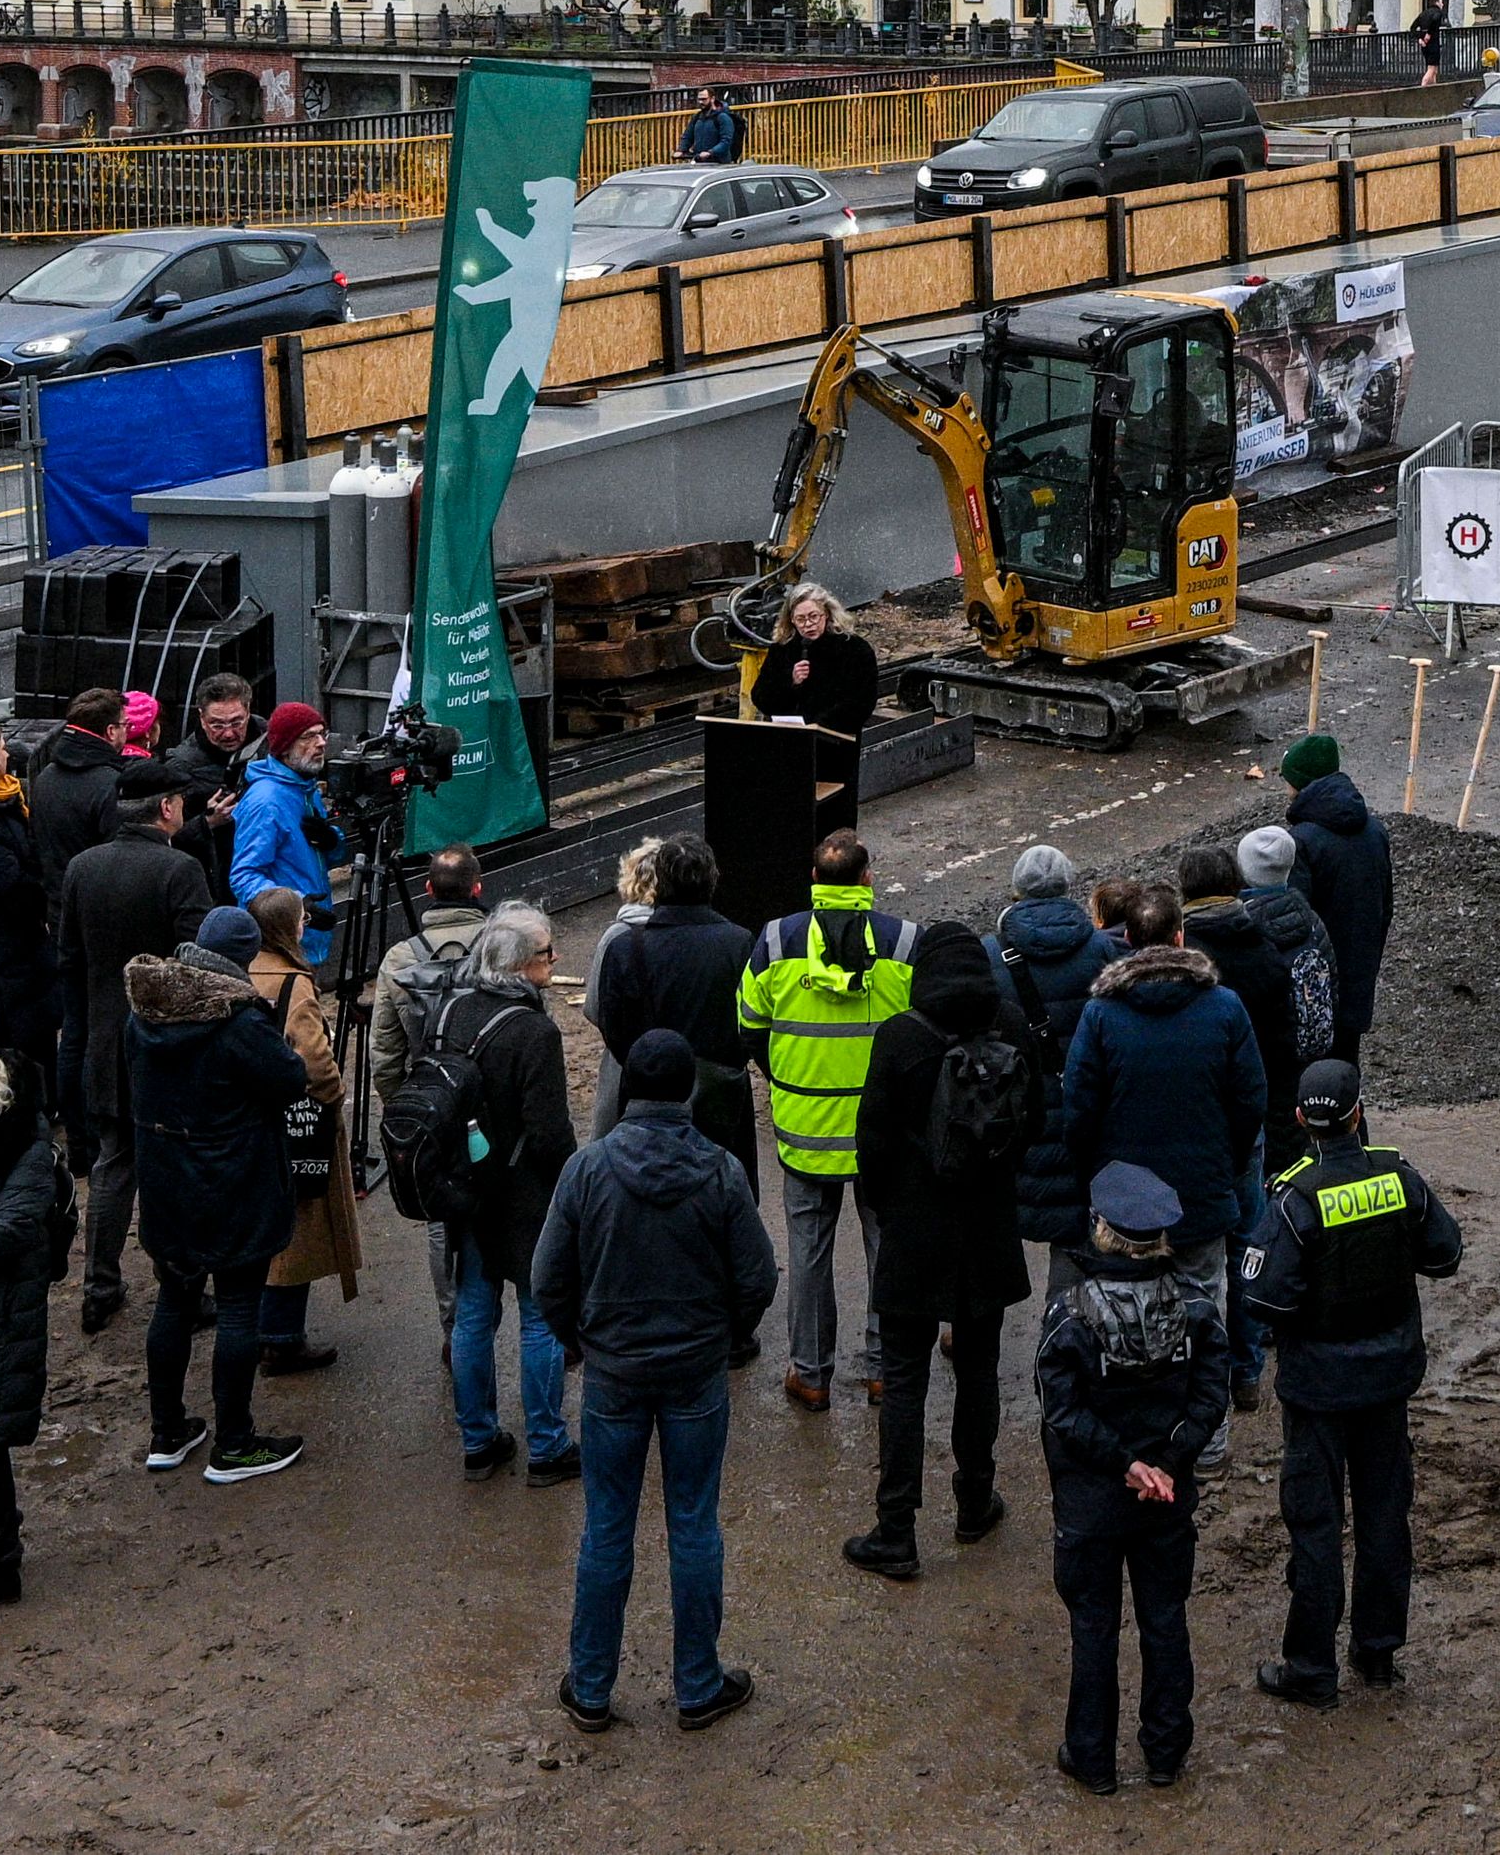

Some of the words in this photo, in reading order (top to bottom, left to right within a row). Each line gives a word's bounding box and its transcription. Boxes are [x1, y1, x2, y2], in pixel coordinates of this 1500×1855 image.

[1359, 281, 1396, 300] HÜLSKENS
[923, 409, 943, 430] CAT
[1236, 422, 1283, 453] ANIERUNG
[1254, 439, 1305, 469] WASSER
[1189, 536, 1218, 566] CAT
[1190, 599, 1217, 617] 301.8
[448, 631, 465, 645] für
[447, 692, 469, 707] und
[452, 750, 483, 766] ERLIN
[1304, 1096, 1339, 1109] POLIZEI
[296, 1111, 319, 1123] Who
[300, 1163, 329, 1174] 2024
[1322, 1177, 1402, 1223] POLIZEI
